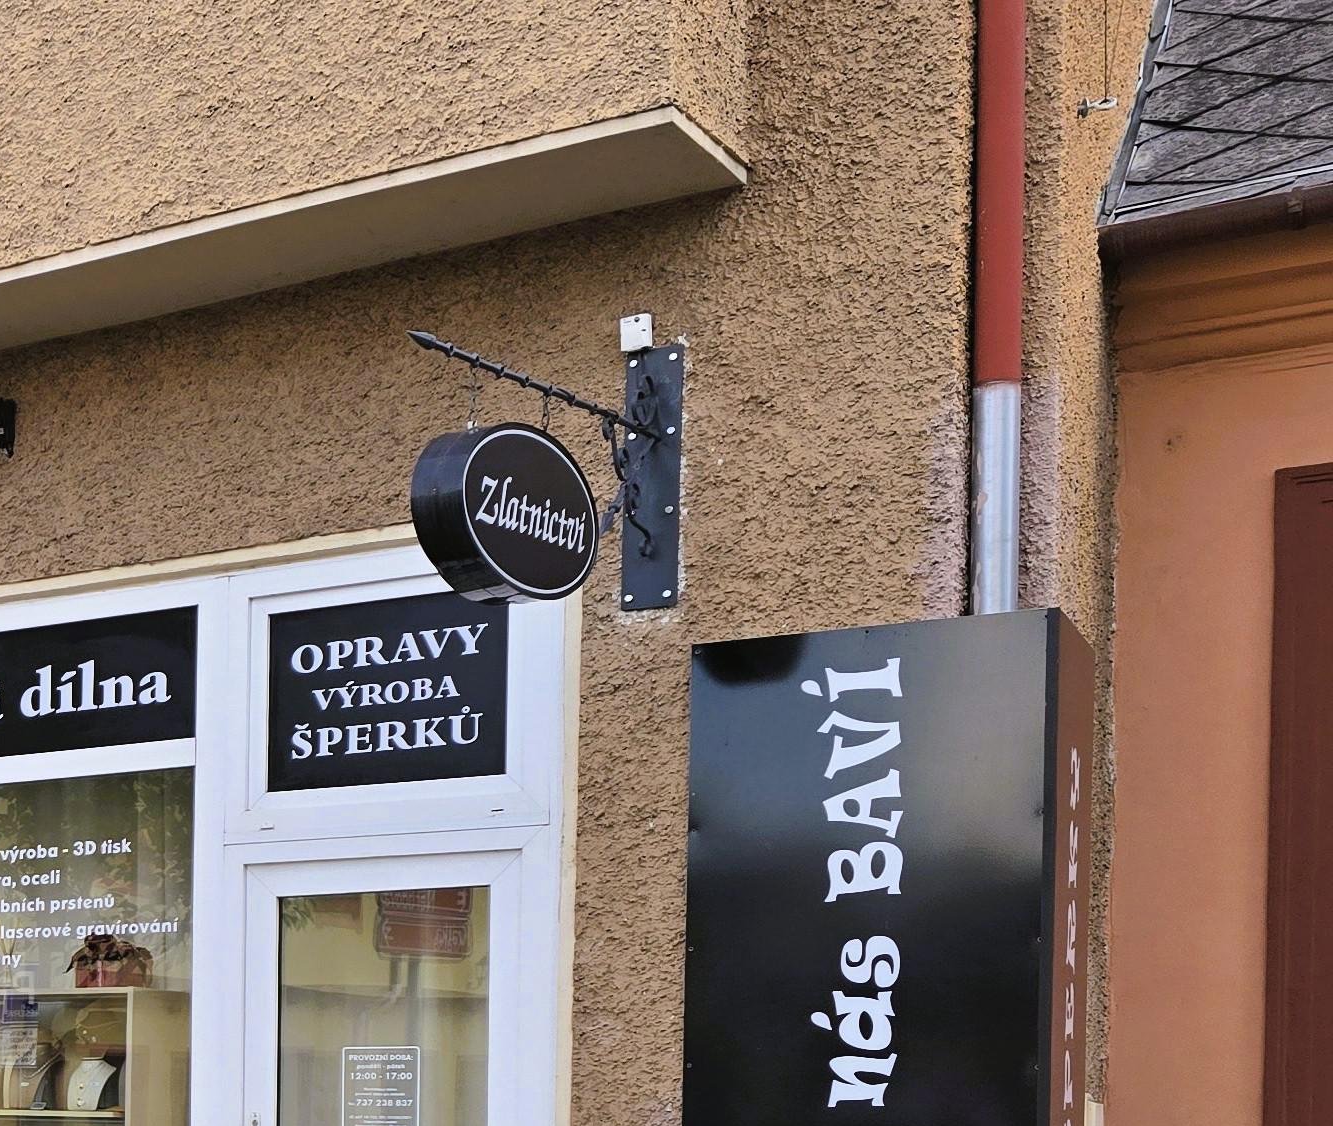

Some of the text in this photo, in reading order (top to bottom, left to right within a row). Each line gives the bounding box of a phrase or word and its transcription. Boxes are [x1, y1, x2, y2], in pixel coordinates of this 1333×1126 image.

[475, 475, 587, 554] Zlatnictví
[290, 622, 489, 675] OPRAVY
[19, 659, 173, 719] dílna
[311, 675, 461, 711] VÝROBA
[289, 704, 484, 761] ŠPERKŮ
[800, 656, 905, 904] BAVÍ
[0, 844, 59, 864] výroba
[73, 840, 97, 857] 3D
[100, 838, 132, 856] tisk
[20, 869, 61, 886] oceli
[49, 893, 115, 914] prstenů
[0, 922, 72, 940] laserové
[76, 916, 179, 939] gravírování
[810, 934, 903, 1108] nás
[348, 1053, 389, 1061] PROVOZNÍ
[350, 1072, 377, 1080] 12:00
[385, 1072, 413, 1080] 17:00
[356, 1099, 374, 1107] 737
[395, 1099, 413, 1107] 837
